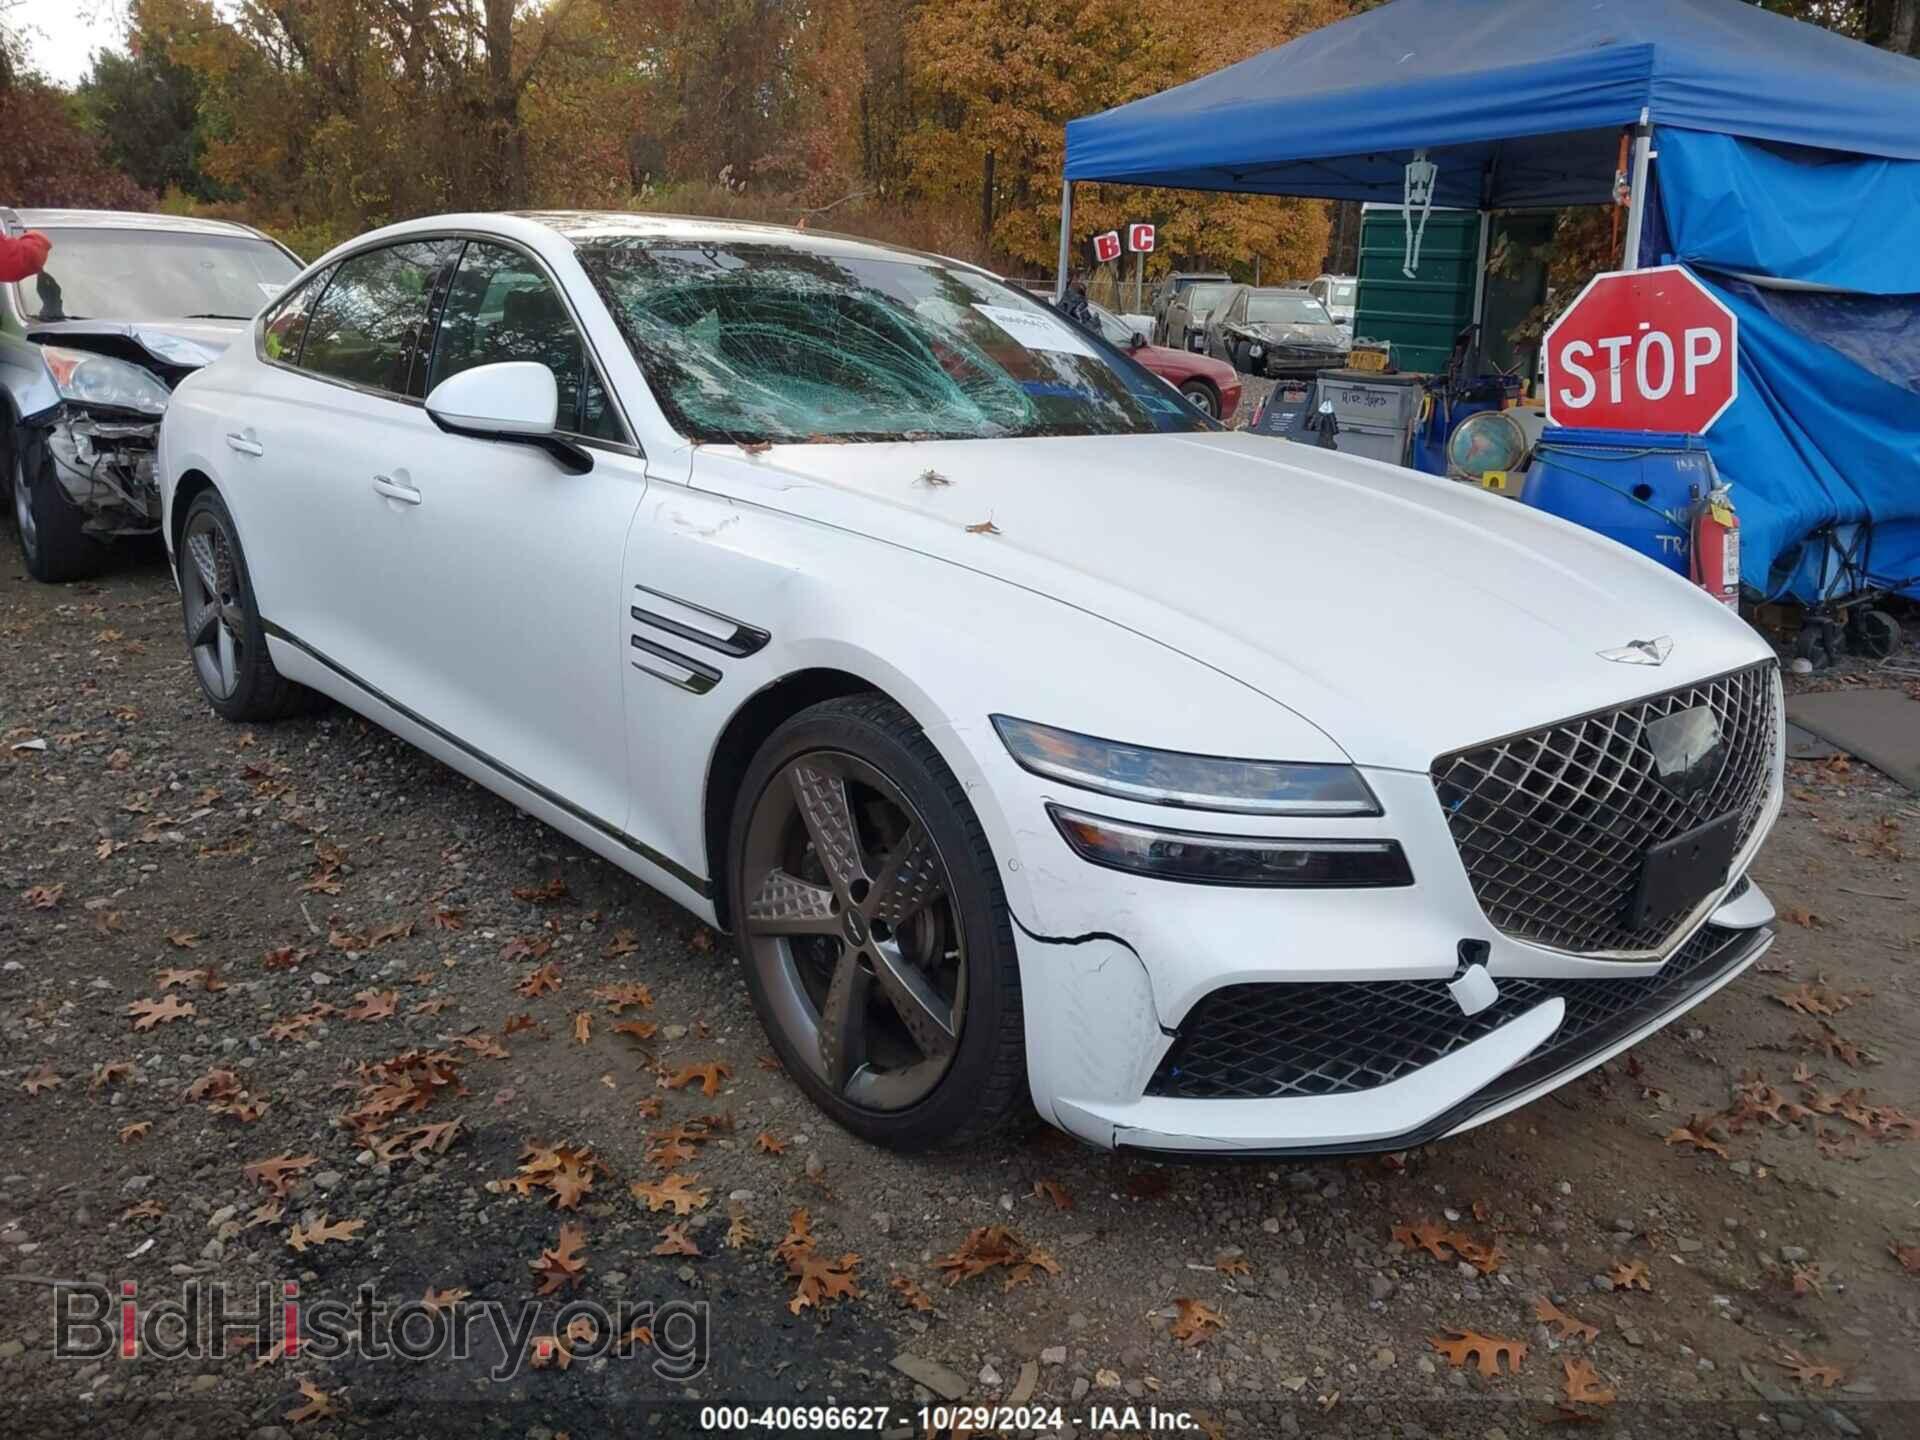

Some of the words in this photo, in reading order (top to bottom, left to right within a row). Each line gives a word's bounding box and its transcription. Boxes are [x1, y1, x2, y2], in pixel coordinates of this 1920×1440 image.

[1097, 234, 1120, 261] B
[1132, 225, 1154, 251] C
[1559, 326, 1722, 409] STOP
